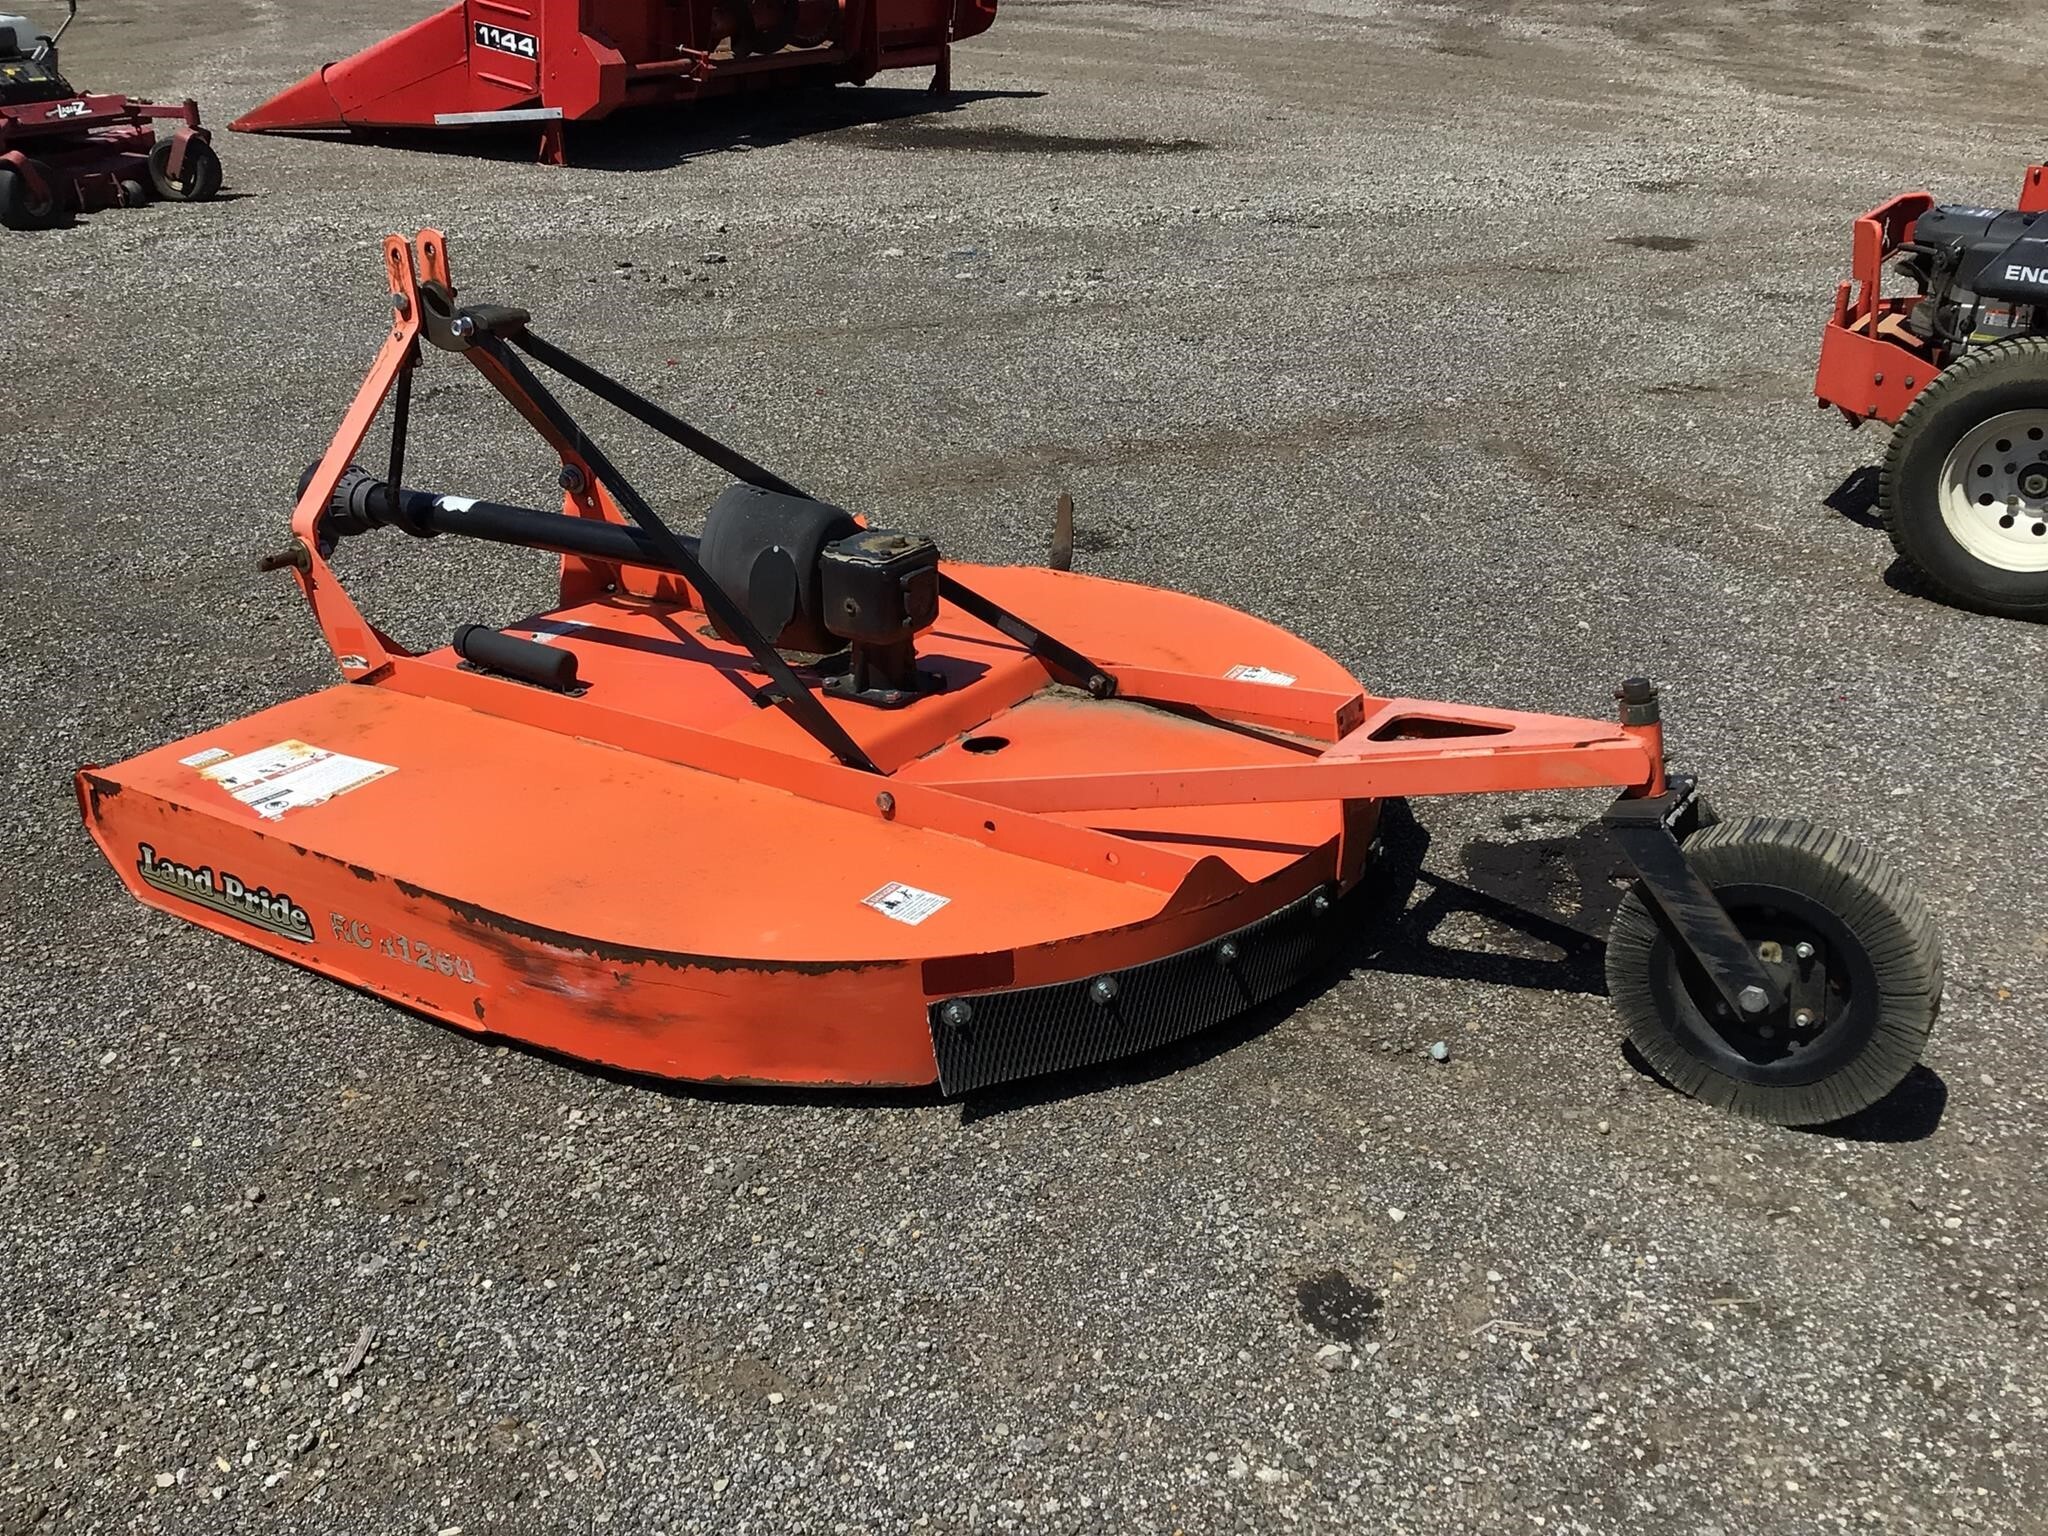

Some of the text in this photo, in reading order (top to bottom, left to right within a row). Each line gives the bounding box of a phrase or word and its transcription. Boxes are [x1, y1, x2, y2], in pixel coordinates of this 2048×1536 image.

[479, 26, 534, 57] 1144
[139, 844, 309, 931] Land Pride
